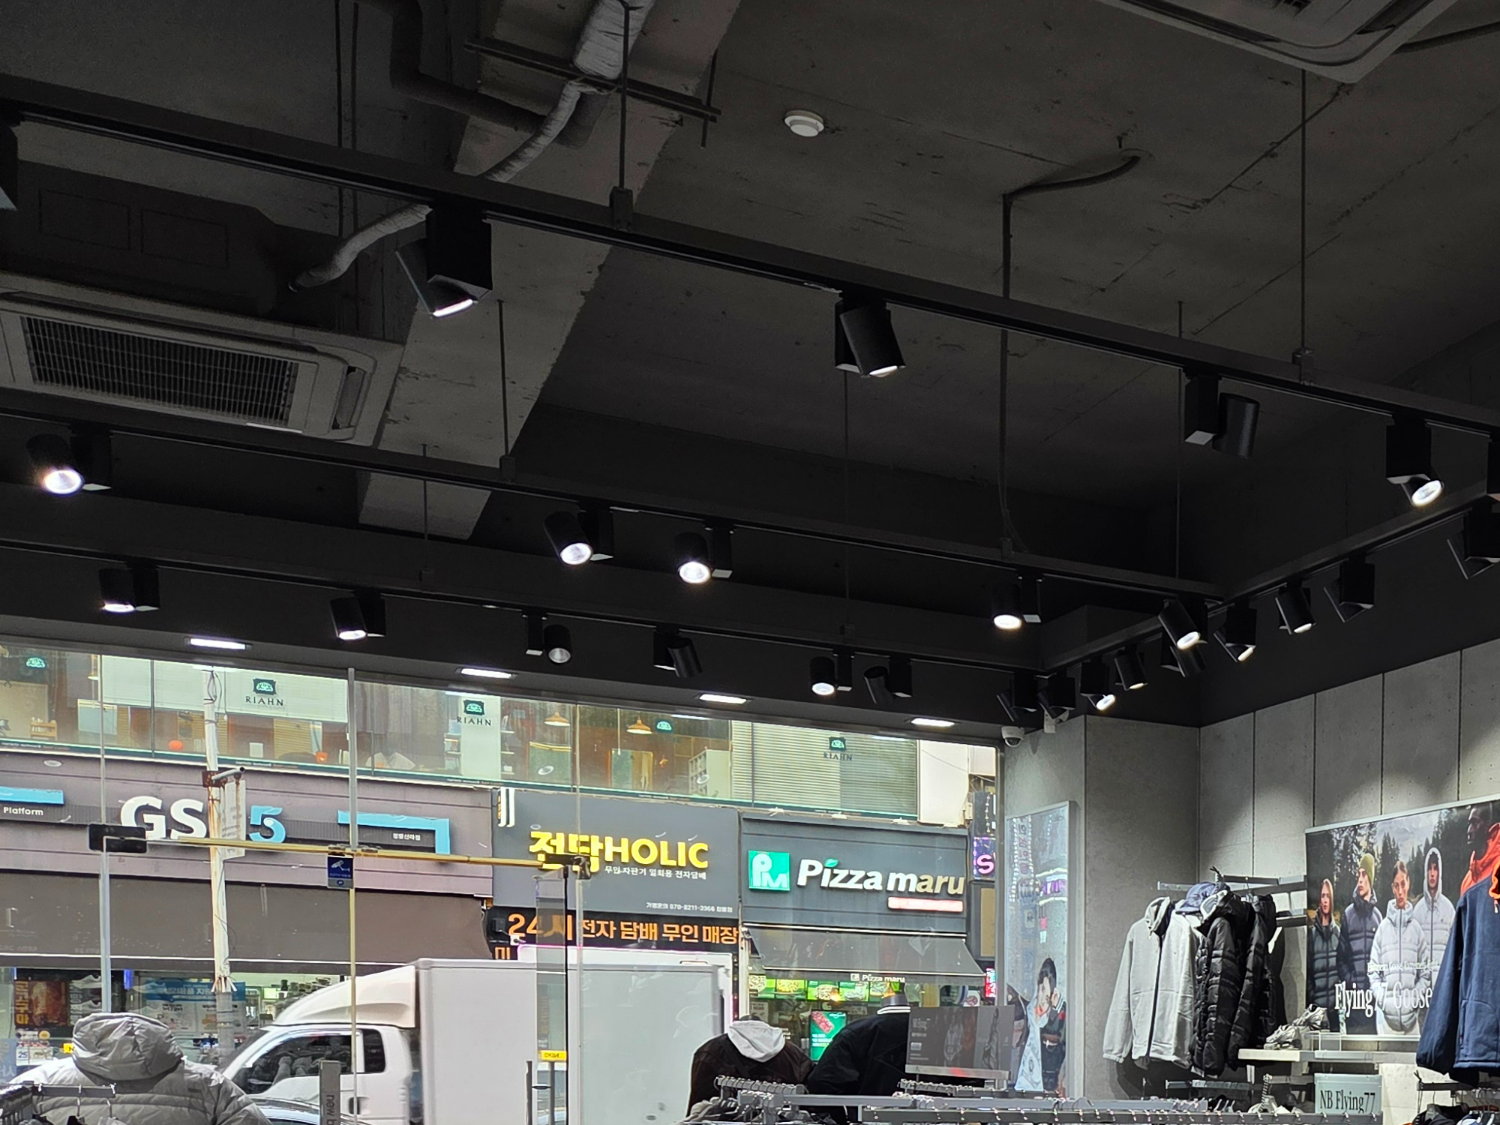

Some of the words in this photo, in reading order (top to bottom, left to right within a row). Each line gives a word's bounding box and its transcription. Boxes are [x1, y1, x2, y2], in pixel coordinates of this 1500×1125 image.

[245, 696, 285, 707] RIAHN
[456, 716, 493, 727] RIAHN
[3, 806, 44, 817] Platform
[120, 795, 286, 844] GS5
[797, 858, 882, 892] Pizza
[887, 872, 965, 896] maru
[620, 922, 658, 941] 담배
[662, 923, 699, 943] 무인
[702, 925, 739, 944] 매장
[1392, 981, 1434, 1010] Goose
[326, 1094, 335, 1117] new
[1320, 1089, 1333, 1110] NB
[1335, 1089, 1376, 1113] Flying77
